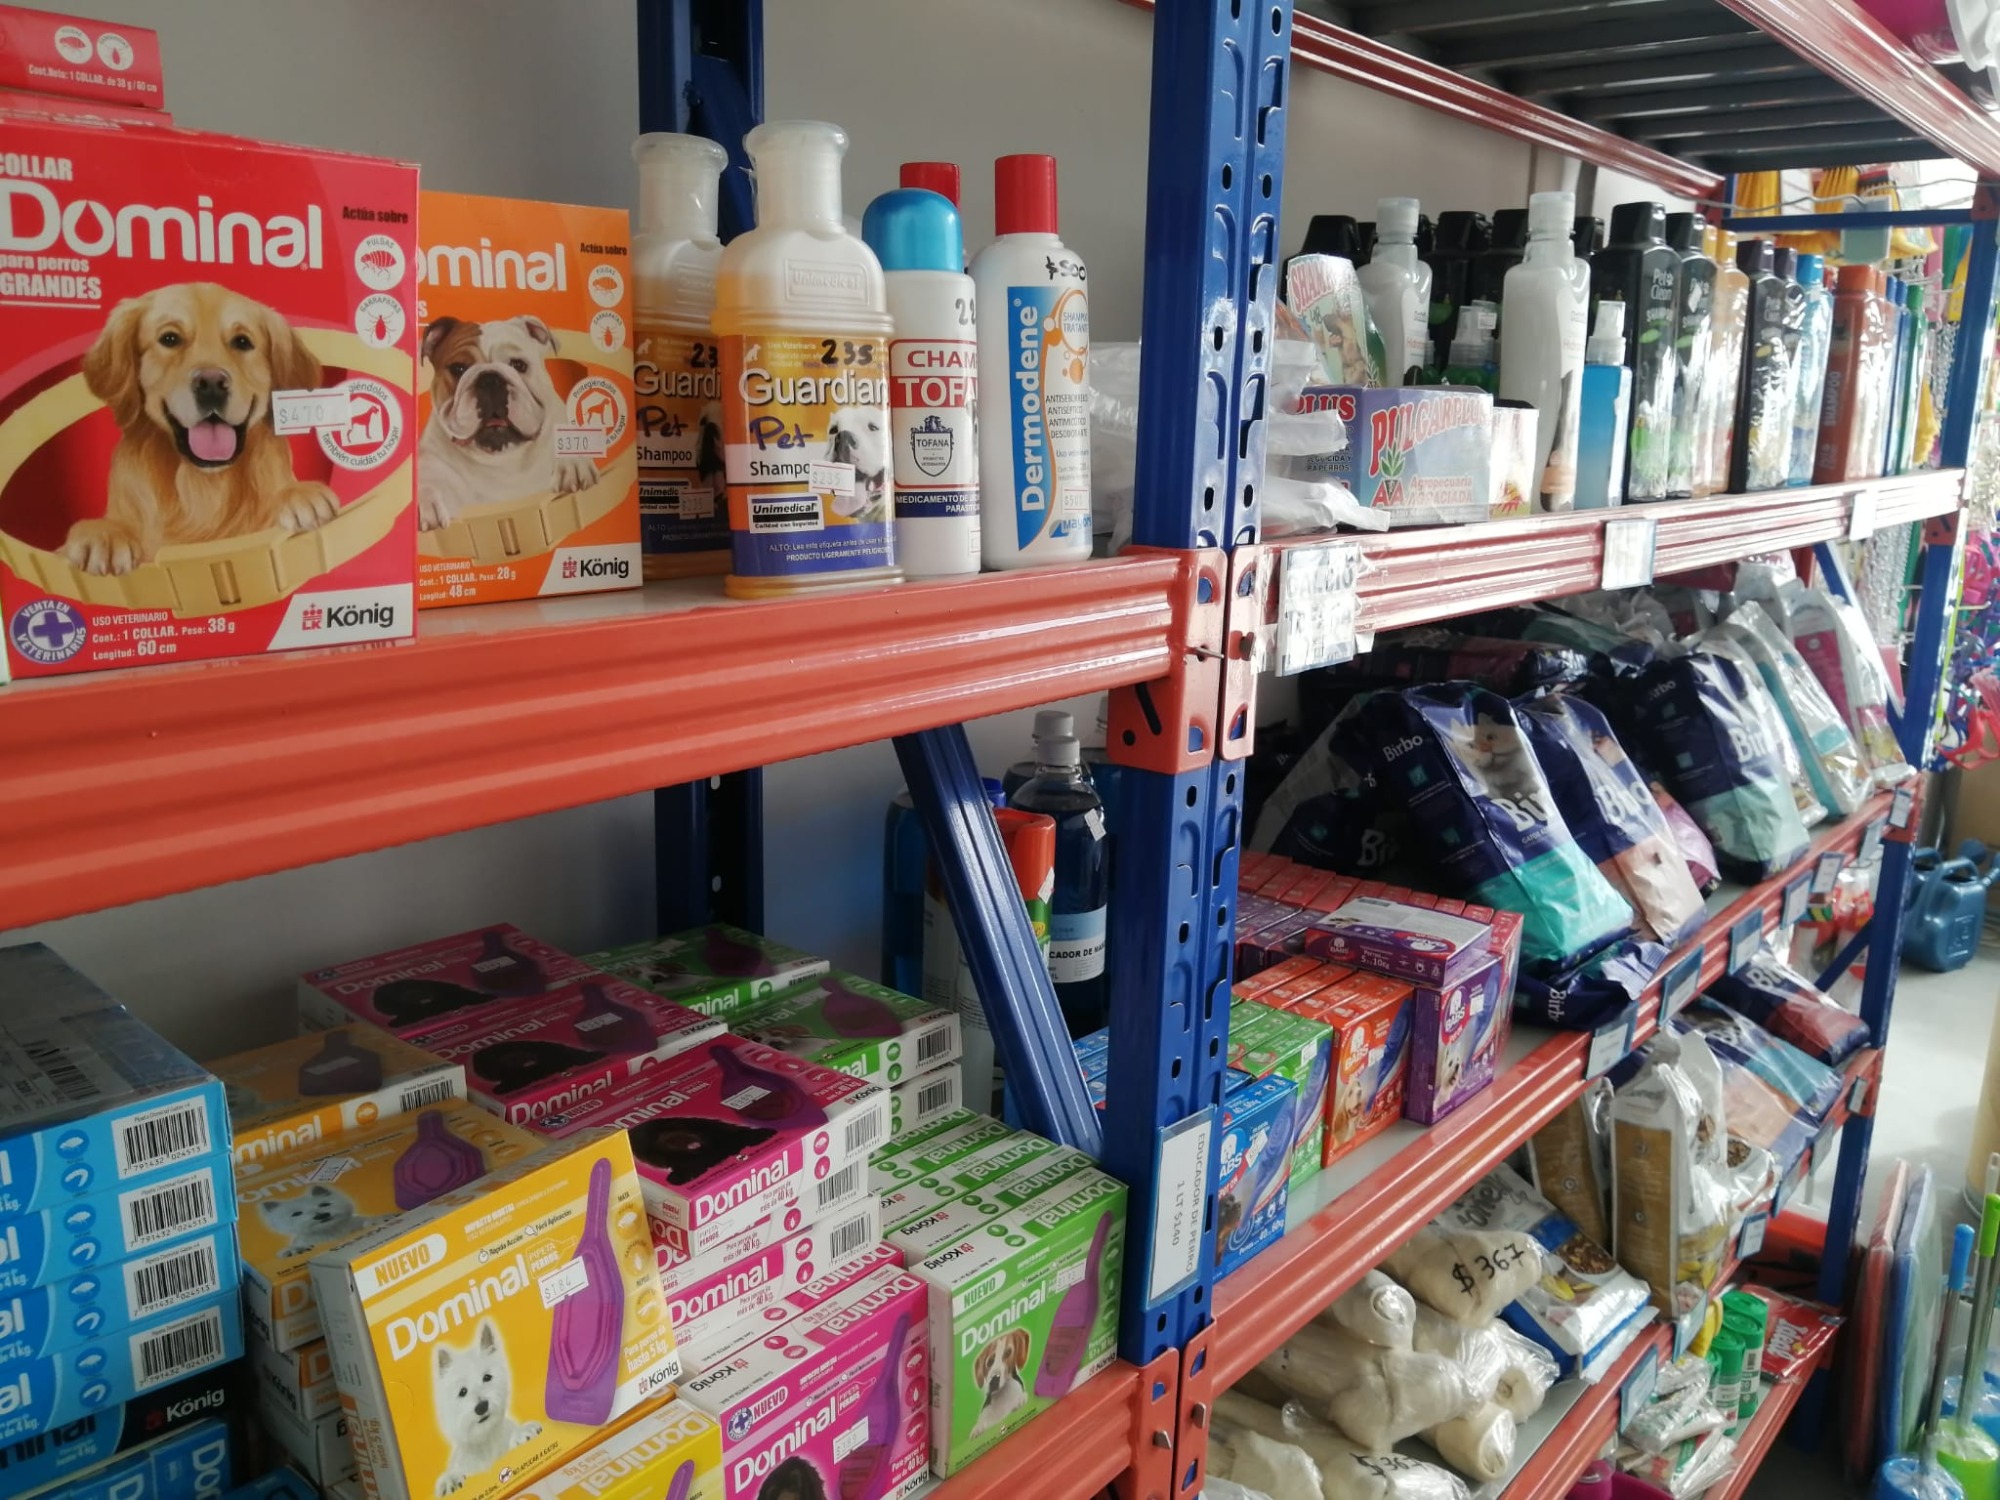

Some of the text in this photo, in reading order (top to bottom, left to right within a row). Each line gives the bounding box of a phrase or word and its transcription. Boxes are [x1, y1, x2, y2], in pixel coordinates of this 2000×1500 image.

[0, 179, 324, 269] Dominal
[343, 205, 409, 224] Actúa sobre
[366, 236, 395, 249] PULGAS
[580, 242, 628, 256] Actúa sobre
[0, 254, 90, 273] para perros
[0, 272, 102, 300] GRANDES
[821, 338, 873, 366] 235
[634, 361, 721, 399] Guardi
[739, 367, 889, 406] Guardian
[279, 404, 324, 424] $470
[637, 405, 689, 438] Pet
[1013, 306, 1044, 512] Dermodene
[322, 426, 400, 466] también cuidás tu hogar
[557, 436, 588, 451] $370
[750, 416, 814, 450] Pet
[916, 439, 949, 448] TOFANA
[637, 445, 693, 464] Shampoo
[749, 461, 810, 478] Shampo
[753, 502, 815, 515] Unimedical
[896, 494, 959, 504] MEDICAMENTO
[769, 544, 792, 552] ALTO:
[786, 553, 820, 562] PRODUCTO
[433, 560, 470, 571] VETERINARIO
[446, 572, 477, 584] COLLAR.
[497, 567, 510, 580] 28
[511, 570, 516, 580] g
[580, 556, 629, 579] König
[449, 584, 463, 598] 48
[464, 587, 476, 597] cm
[22, 600, 70, 618] VENTA EN
[93, 612, 168, 626] USO VETERINARIO
[326, 604, 394, 628] König
[16, 627, 87, 661] VETERINARIAS
[93, 617, 236, 643] Cont.: 1 COLLAR. Peso: 38 g
[94, 641, 177, 660] Longitud: 60 cm
[1382, 733, 1424, 762] Birbo
[1048, 947, 1094, 960] CADOR DE
[335, 960, 447, 995] Dominal
[688, 988, 739, 1015] minal
[434, 1018, 547, 1060] Dominal
[510, 1070, 613, 1127] Dominal
[854, 1085, 884, 1101] König
[233, 1115, 323, 1162] minal
[923, 1122, 1009, 1165] Dominal
[965, 1137, 1050, 1181] Dominal
[1219, 1151, 1243, 1180] ABS
[695, 1150, 789, 1227] Dominal
[1007, 1153, 1093, 1200] Dominal
[1034, 1177, 1122, 1229] Dominal
[1175, 1192, 1184, 1210] LT
[1186, 1133, 1206, 1273] EDUCADOR DE PERRO
[464, 1202, 515, 1234] IMPACTO MORTAL
[900, 1213, 942, 1236] König
[375, 1241, 431, 1287] NUEVO
[529, 1243, 557, 1264] PIPETA
[530, 1253, 560, 1273] PERROS
[923, 1245, 967, 1271] König
[800, 1243, 898, 1299] Dominal
[1453, 1242, 1525, 1297] $367
[543, 1275, 572, 1300] $184
[669, 1256, 769, 1329] Dominal
[963, 1276, 997, 1309] NUEVO
[386, 1254, 530, 1361] Dominal
[820, 1275, 921, 1336] Dominal
[961, 1280, 1047, 1358] Dominal
[623, 1343, 638, 1358] Para
[638, 1329, 659, 1351] perros
[626, 1344, 657, 1374] hasta 5
[648, 1361, 680, 1388] König
[689, 1364, 739, 1393] König
[166, 1389, 224, 1422] König
[753, 1388, 787, 1419] NUEVO
[839, 1391, 861, 1411] PERROS
[584, 1416, 709, 1495] Dominal
[734, 1396, 836, 1494] Dominal
[511, 1465, 520, 1477] NO
[520, 1454, 541, 1472] APLICAR
[908, 1459, 917, 1472] 40
[903, 1470, 928, 1493] König
